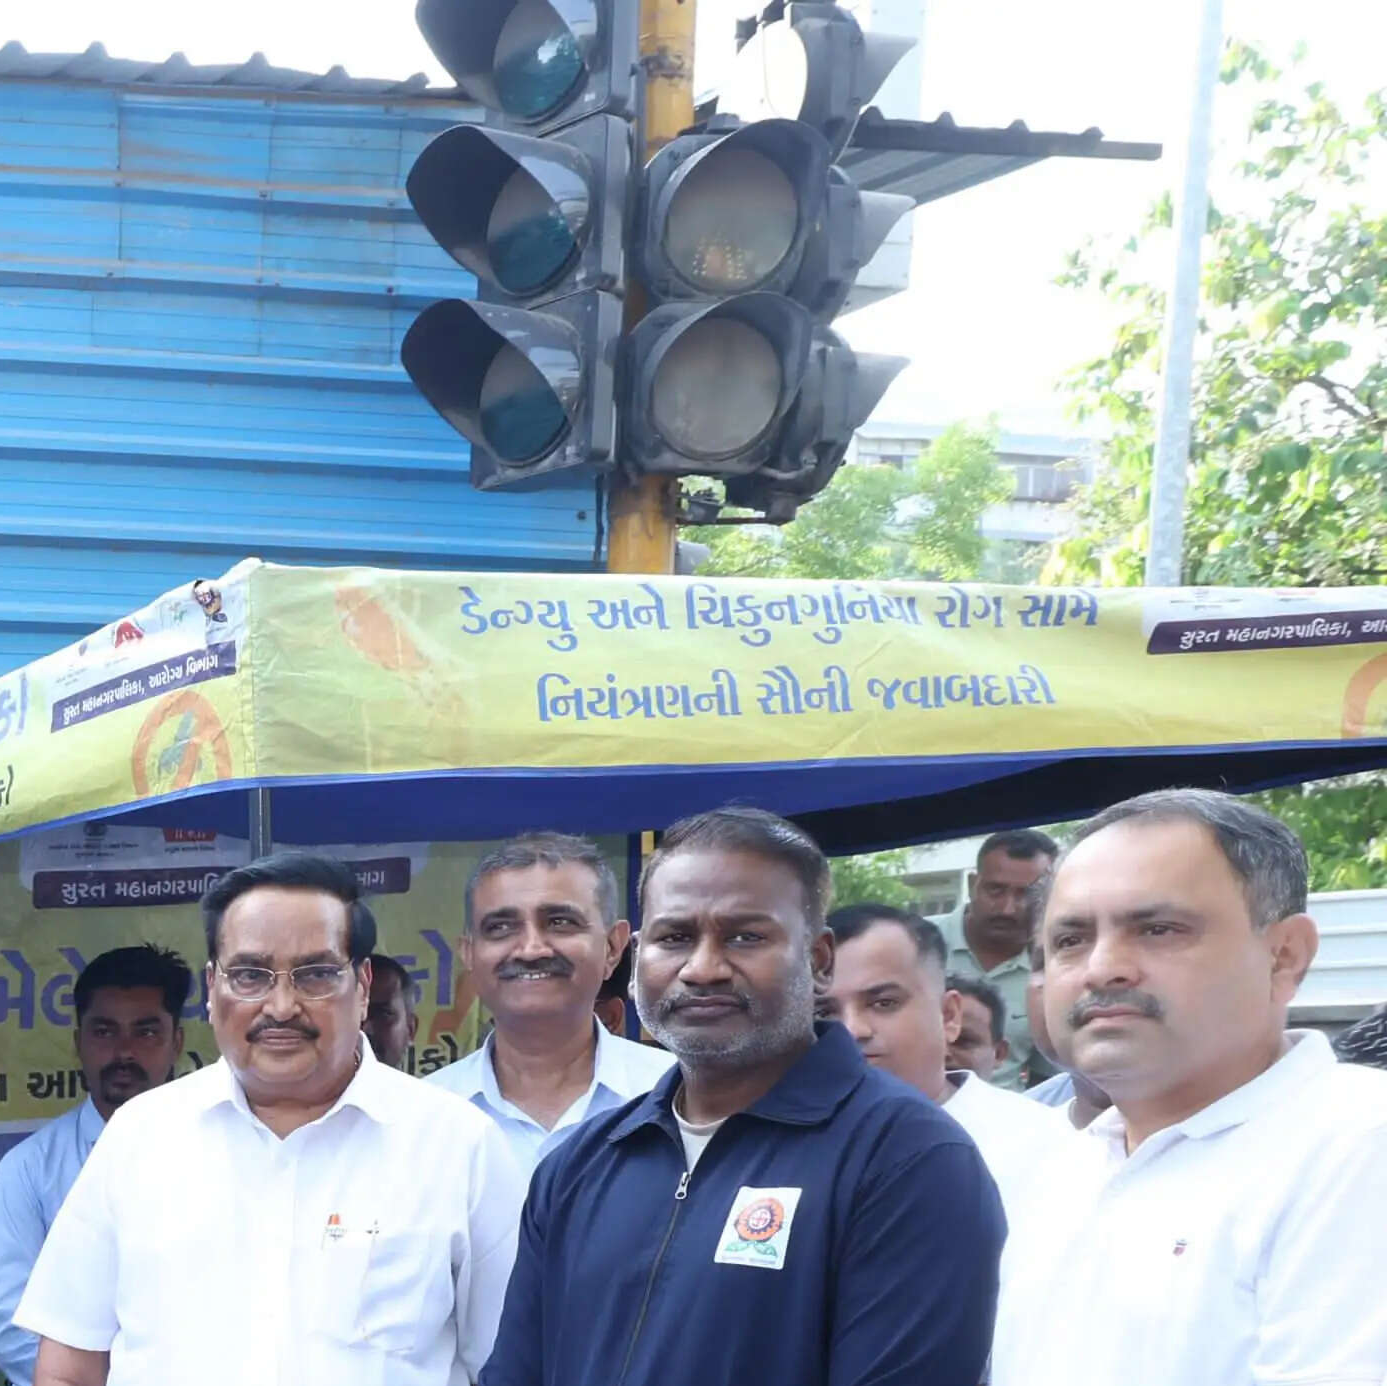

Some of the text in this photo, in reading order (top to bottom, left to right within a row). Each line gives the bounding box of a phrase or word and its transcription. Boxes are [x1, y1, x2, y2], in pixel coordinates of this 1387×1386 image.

[459, 586, 579, 651] ડેન્ગ્યુ
[587, 583, 670, 632] અને
[936, 587, 1004, 629] રોગ
[1180, 629, 1220, 650] સુરત
[1225, 617, 1352, 643] મહાનગરપાલિકા,
[537, 664, 1057, 723] નિયંત્રણની સૌની જવાબદારી
[61, 882, 107, 905] સુરત
